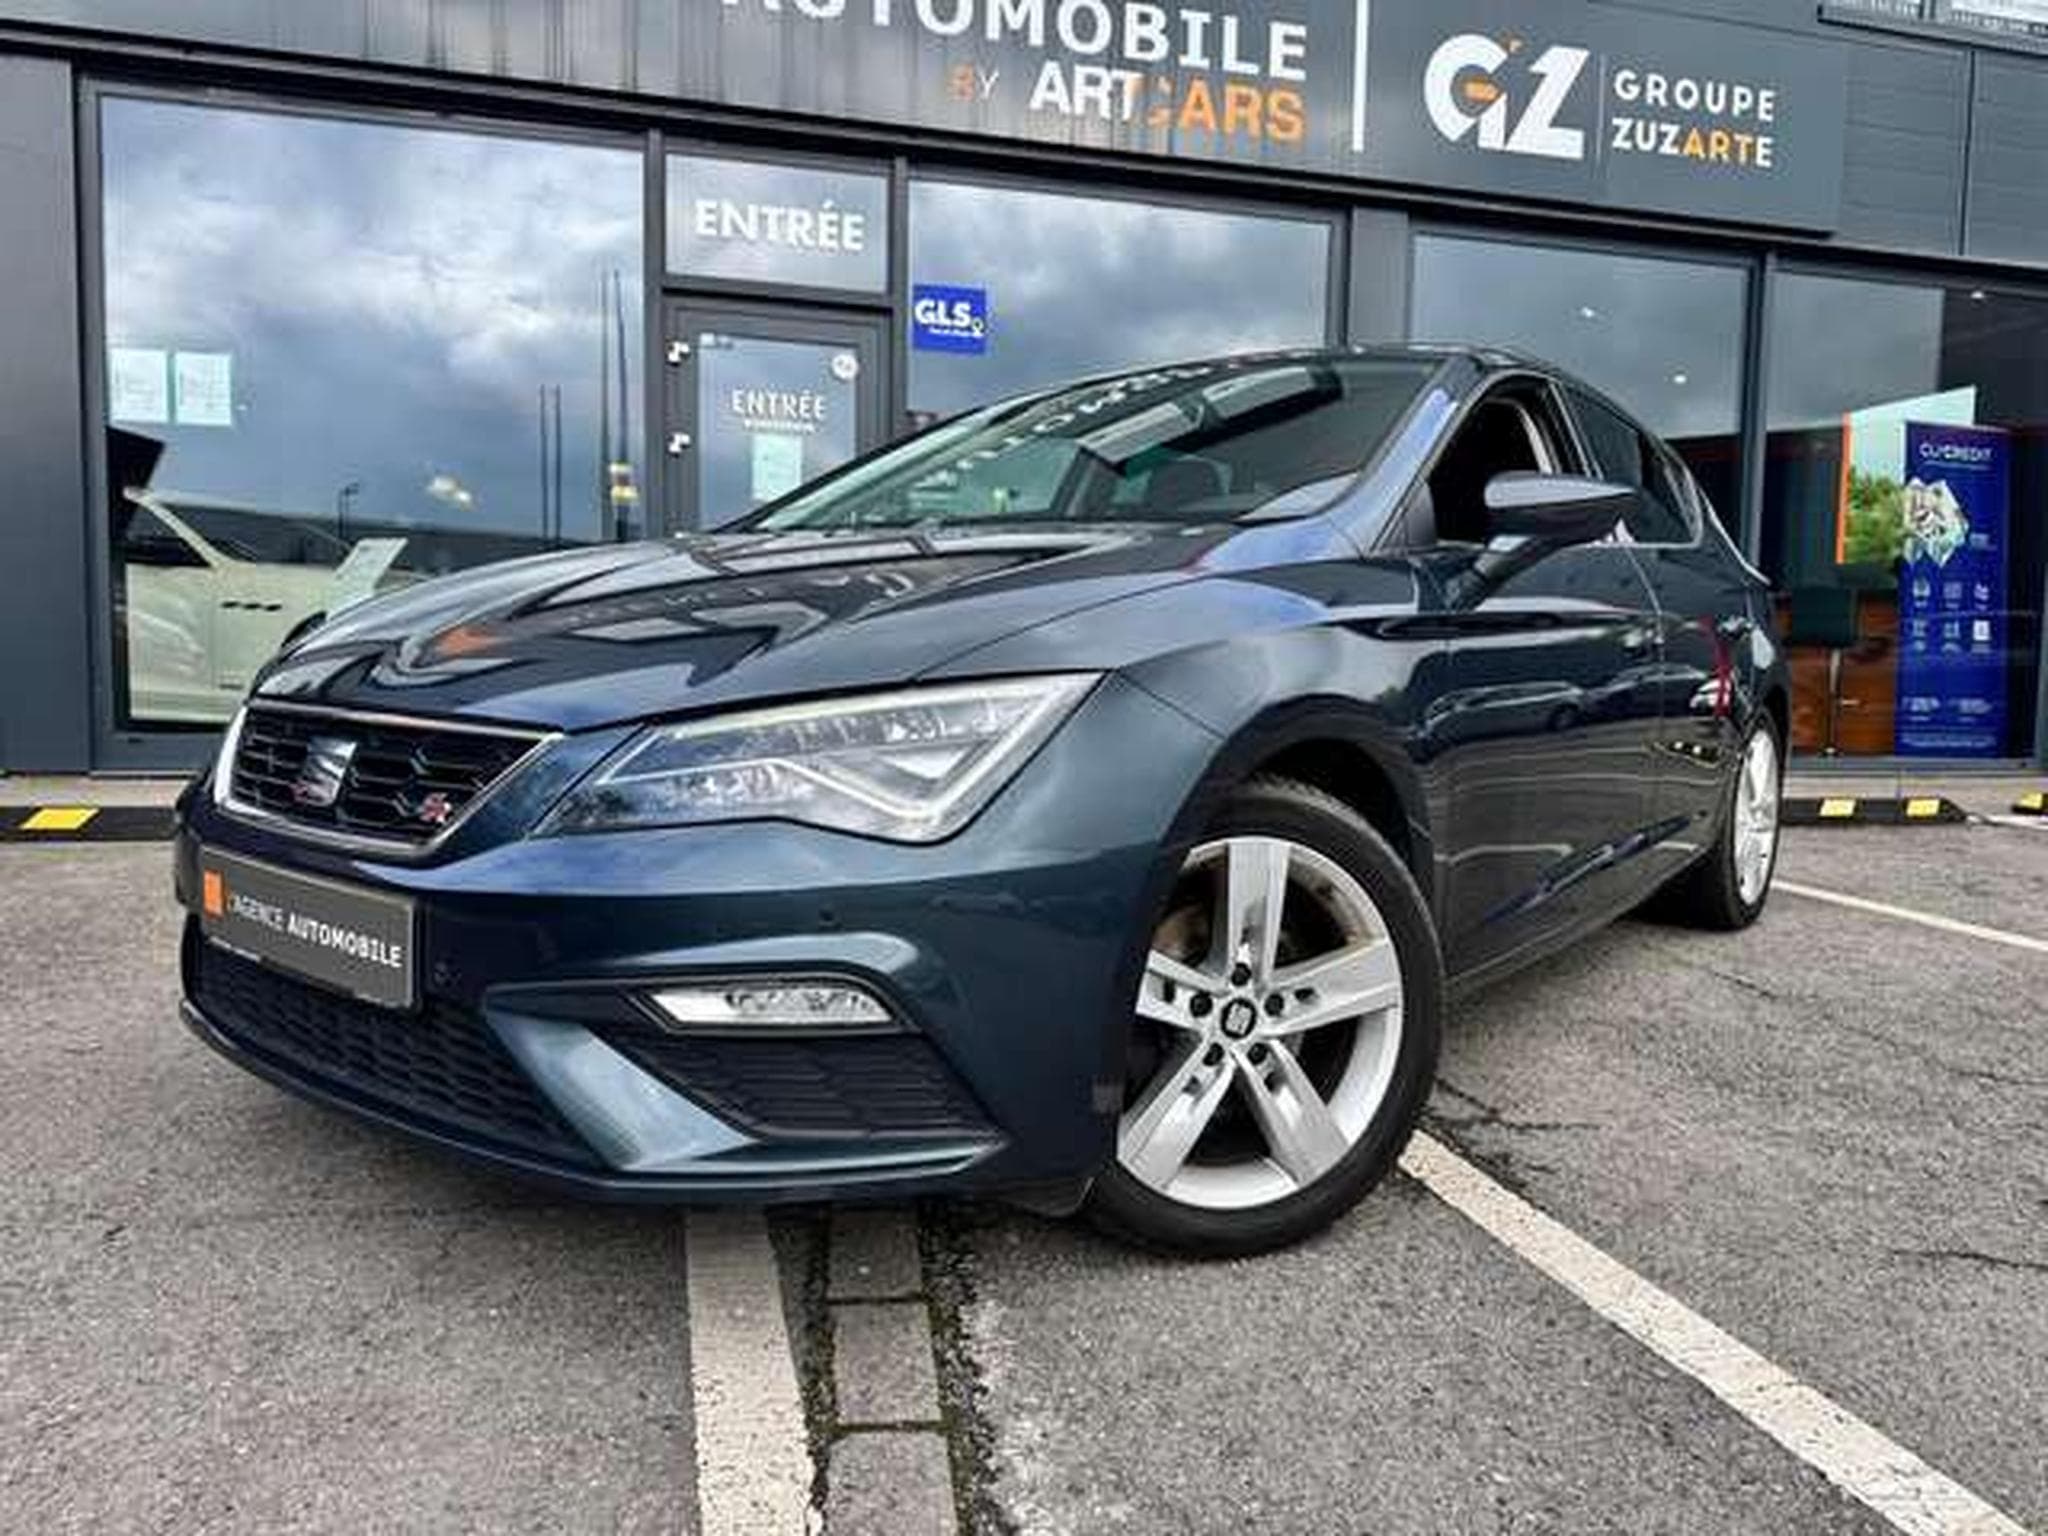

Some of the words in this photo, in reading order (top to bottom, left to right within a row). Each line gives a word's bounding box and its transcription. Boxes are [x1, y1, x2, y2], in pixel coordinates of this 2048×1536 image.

[723, 0, 1307, 80] OMOBILE
[1613, 69, 1776, 122] GROUPE
[1611, 117, 1773, 168] ZUZARTE
[694, 198, 865, 252] ENTRÉE
[914, 298, 971, 328] GLS
[732, 388, 826, 420] ENTRÉE
[287, 912, 402, 968] AUTOMOBILE
